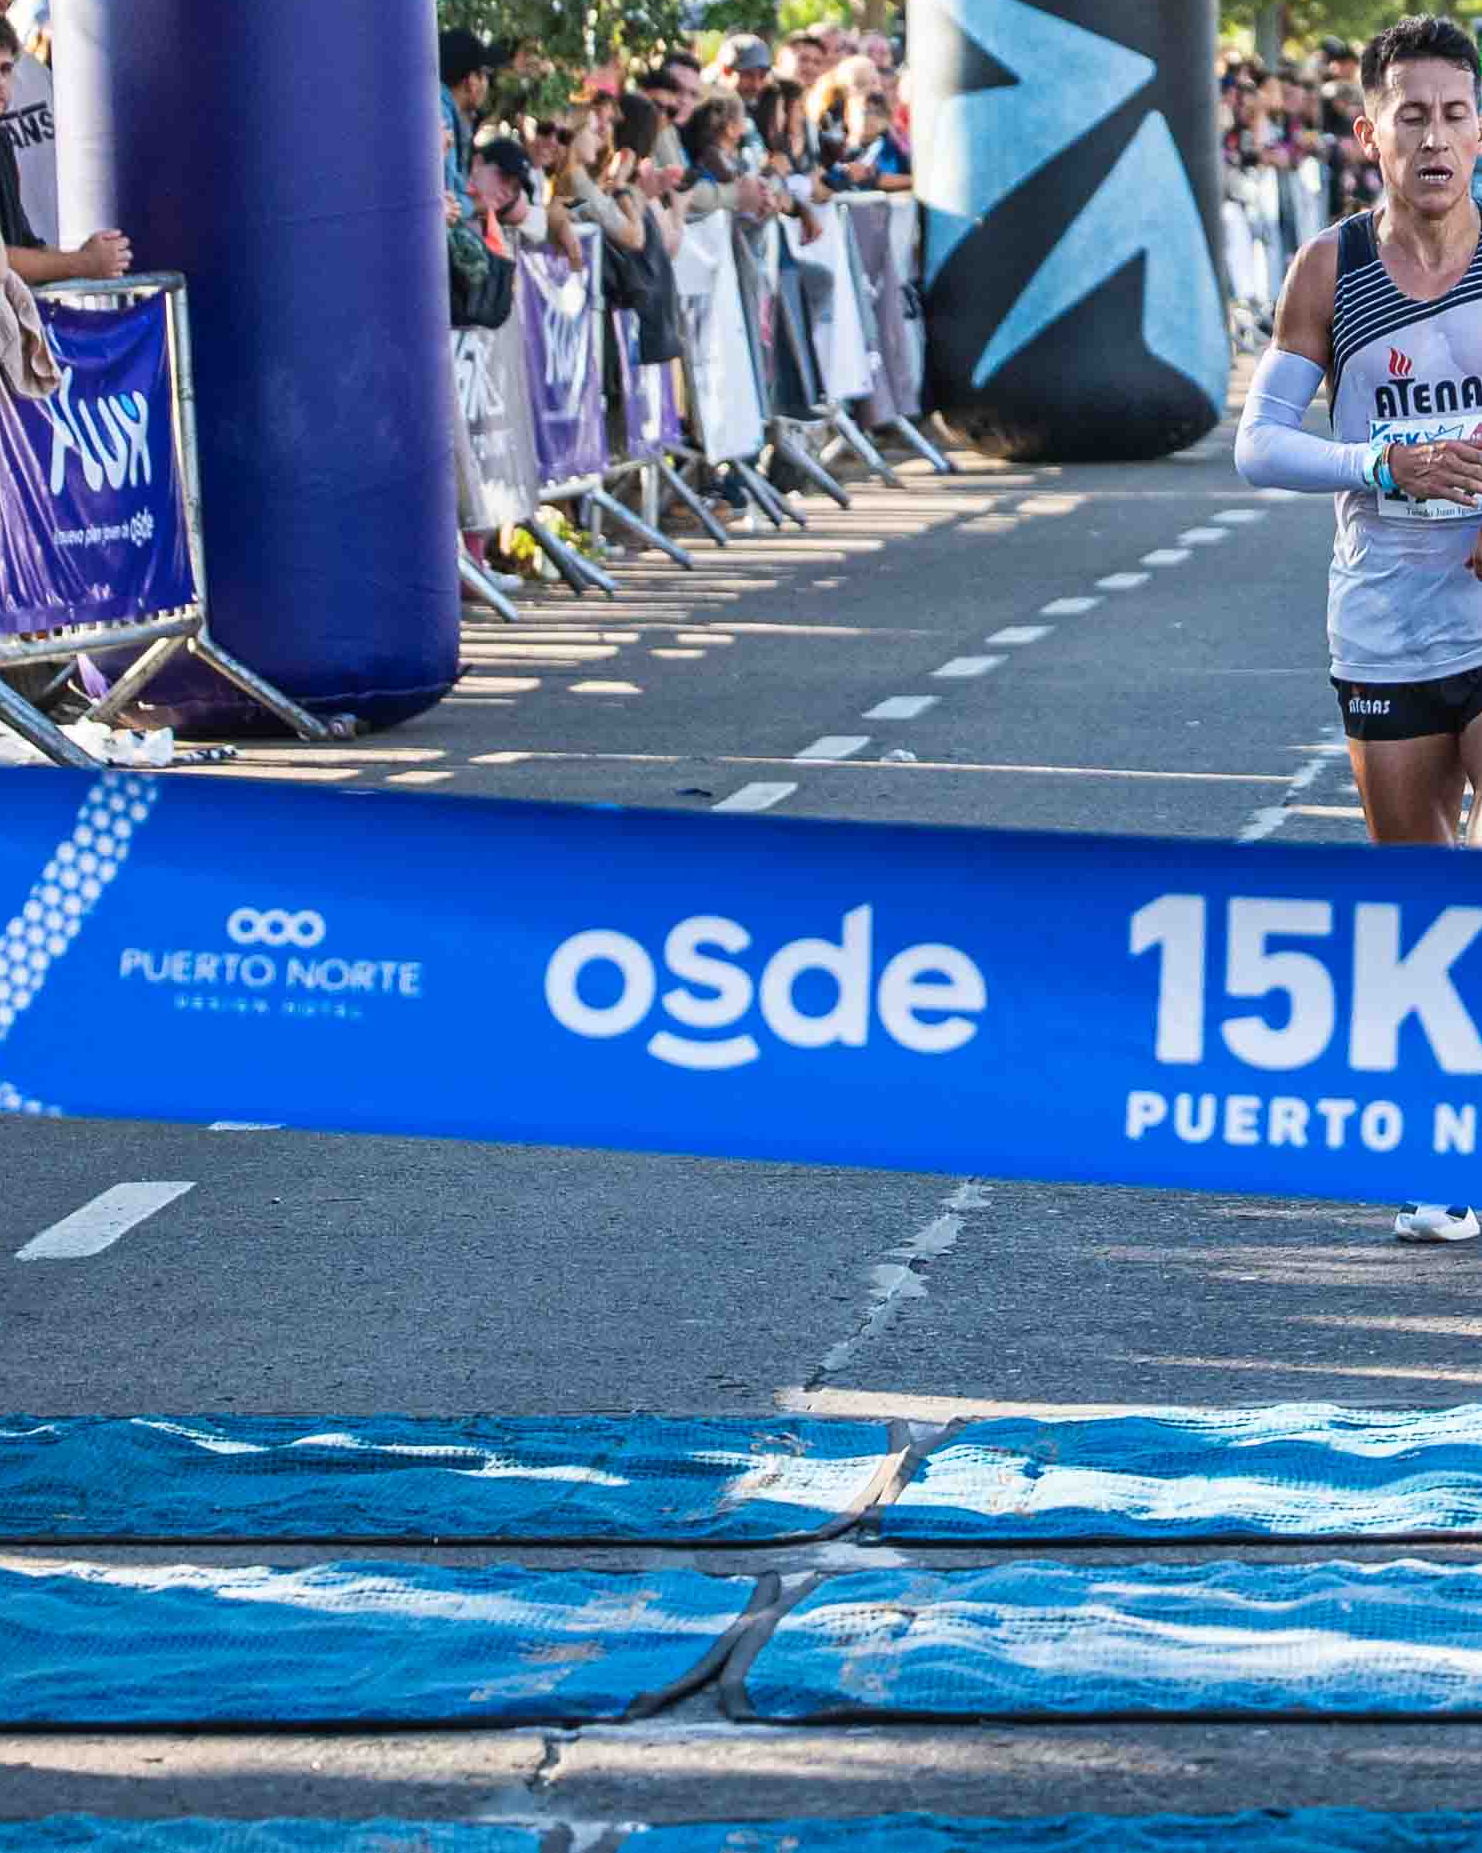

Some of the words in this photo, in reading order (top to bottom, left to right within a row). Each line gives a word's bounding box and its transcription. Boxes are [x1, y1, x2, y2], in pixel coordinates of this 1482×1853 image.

[1, 101, 54, 149] ANS
[120, 947, 276, 989] PUERTO
[285, 956, 422, 997] NORTE
[544, 903, 987, 1070] osde
[1125, 1090, 1404, 1151] PUERTO
